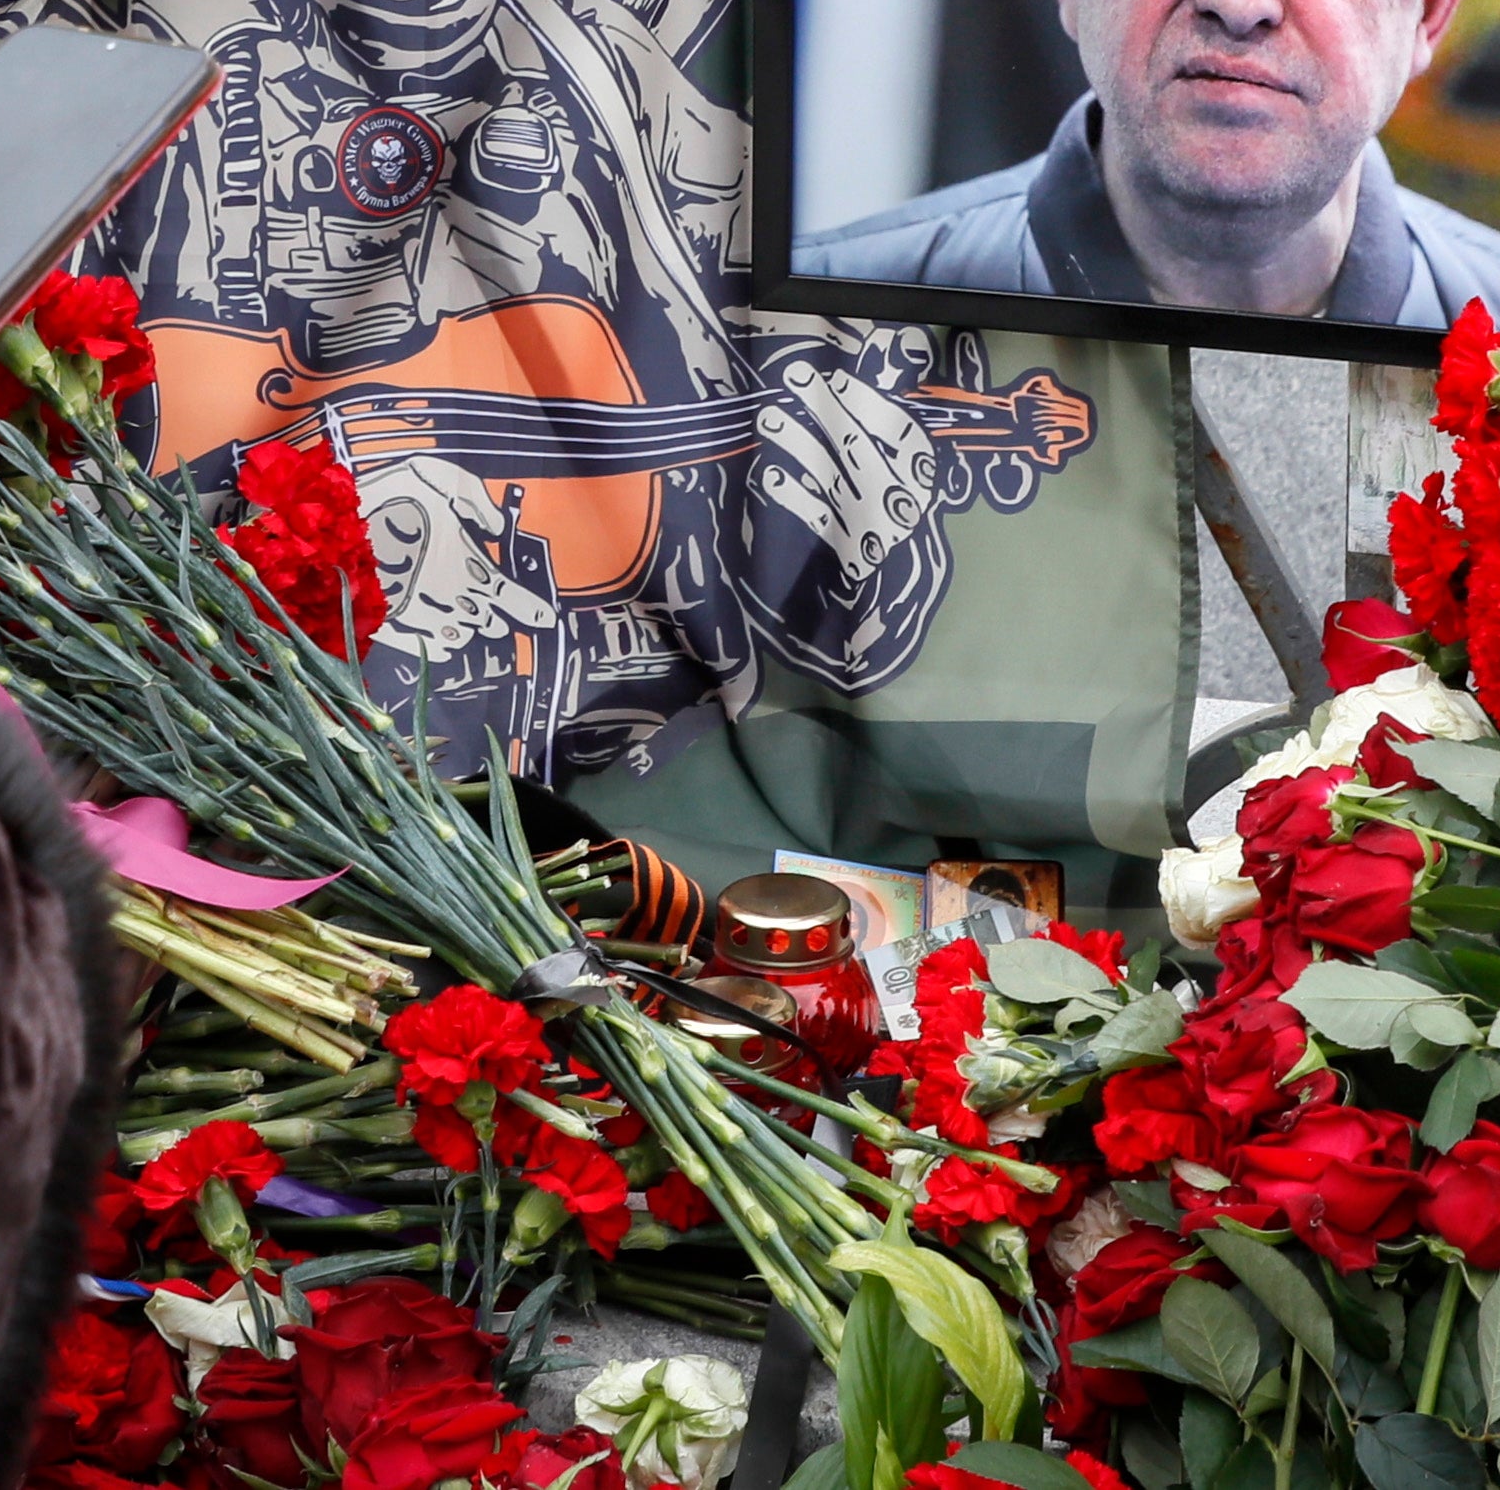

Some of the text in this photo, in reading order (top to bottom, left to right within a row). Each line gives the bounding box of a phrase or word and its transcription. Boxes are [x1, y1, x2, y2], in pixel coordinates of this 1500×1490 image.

[345, 118, 432, 173] PMC Wagner Group
[356, 176, 428, 208] Группа Вагнера
[882, 966, 914, 994] 10
